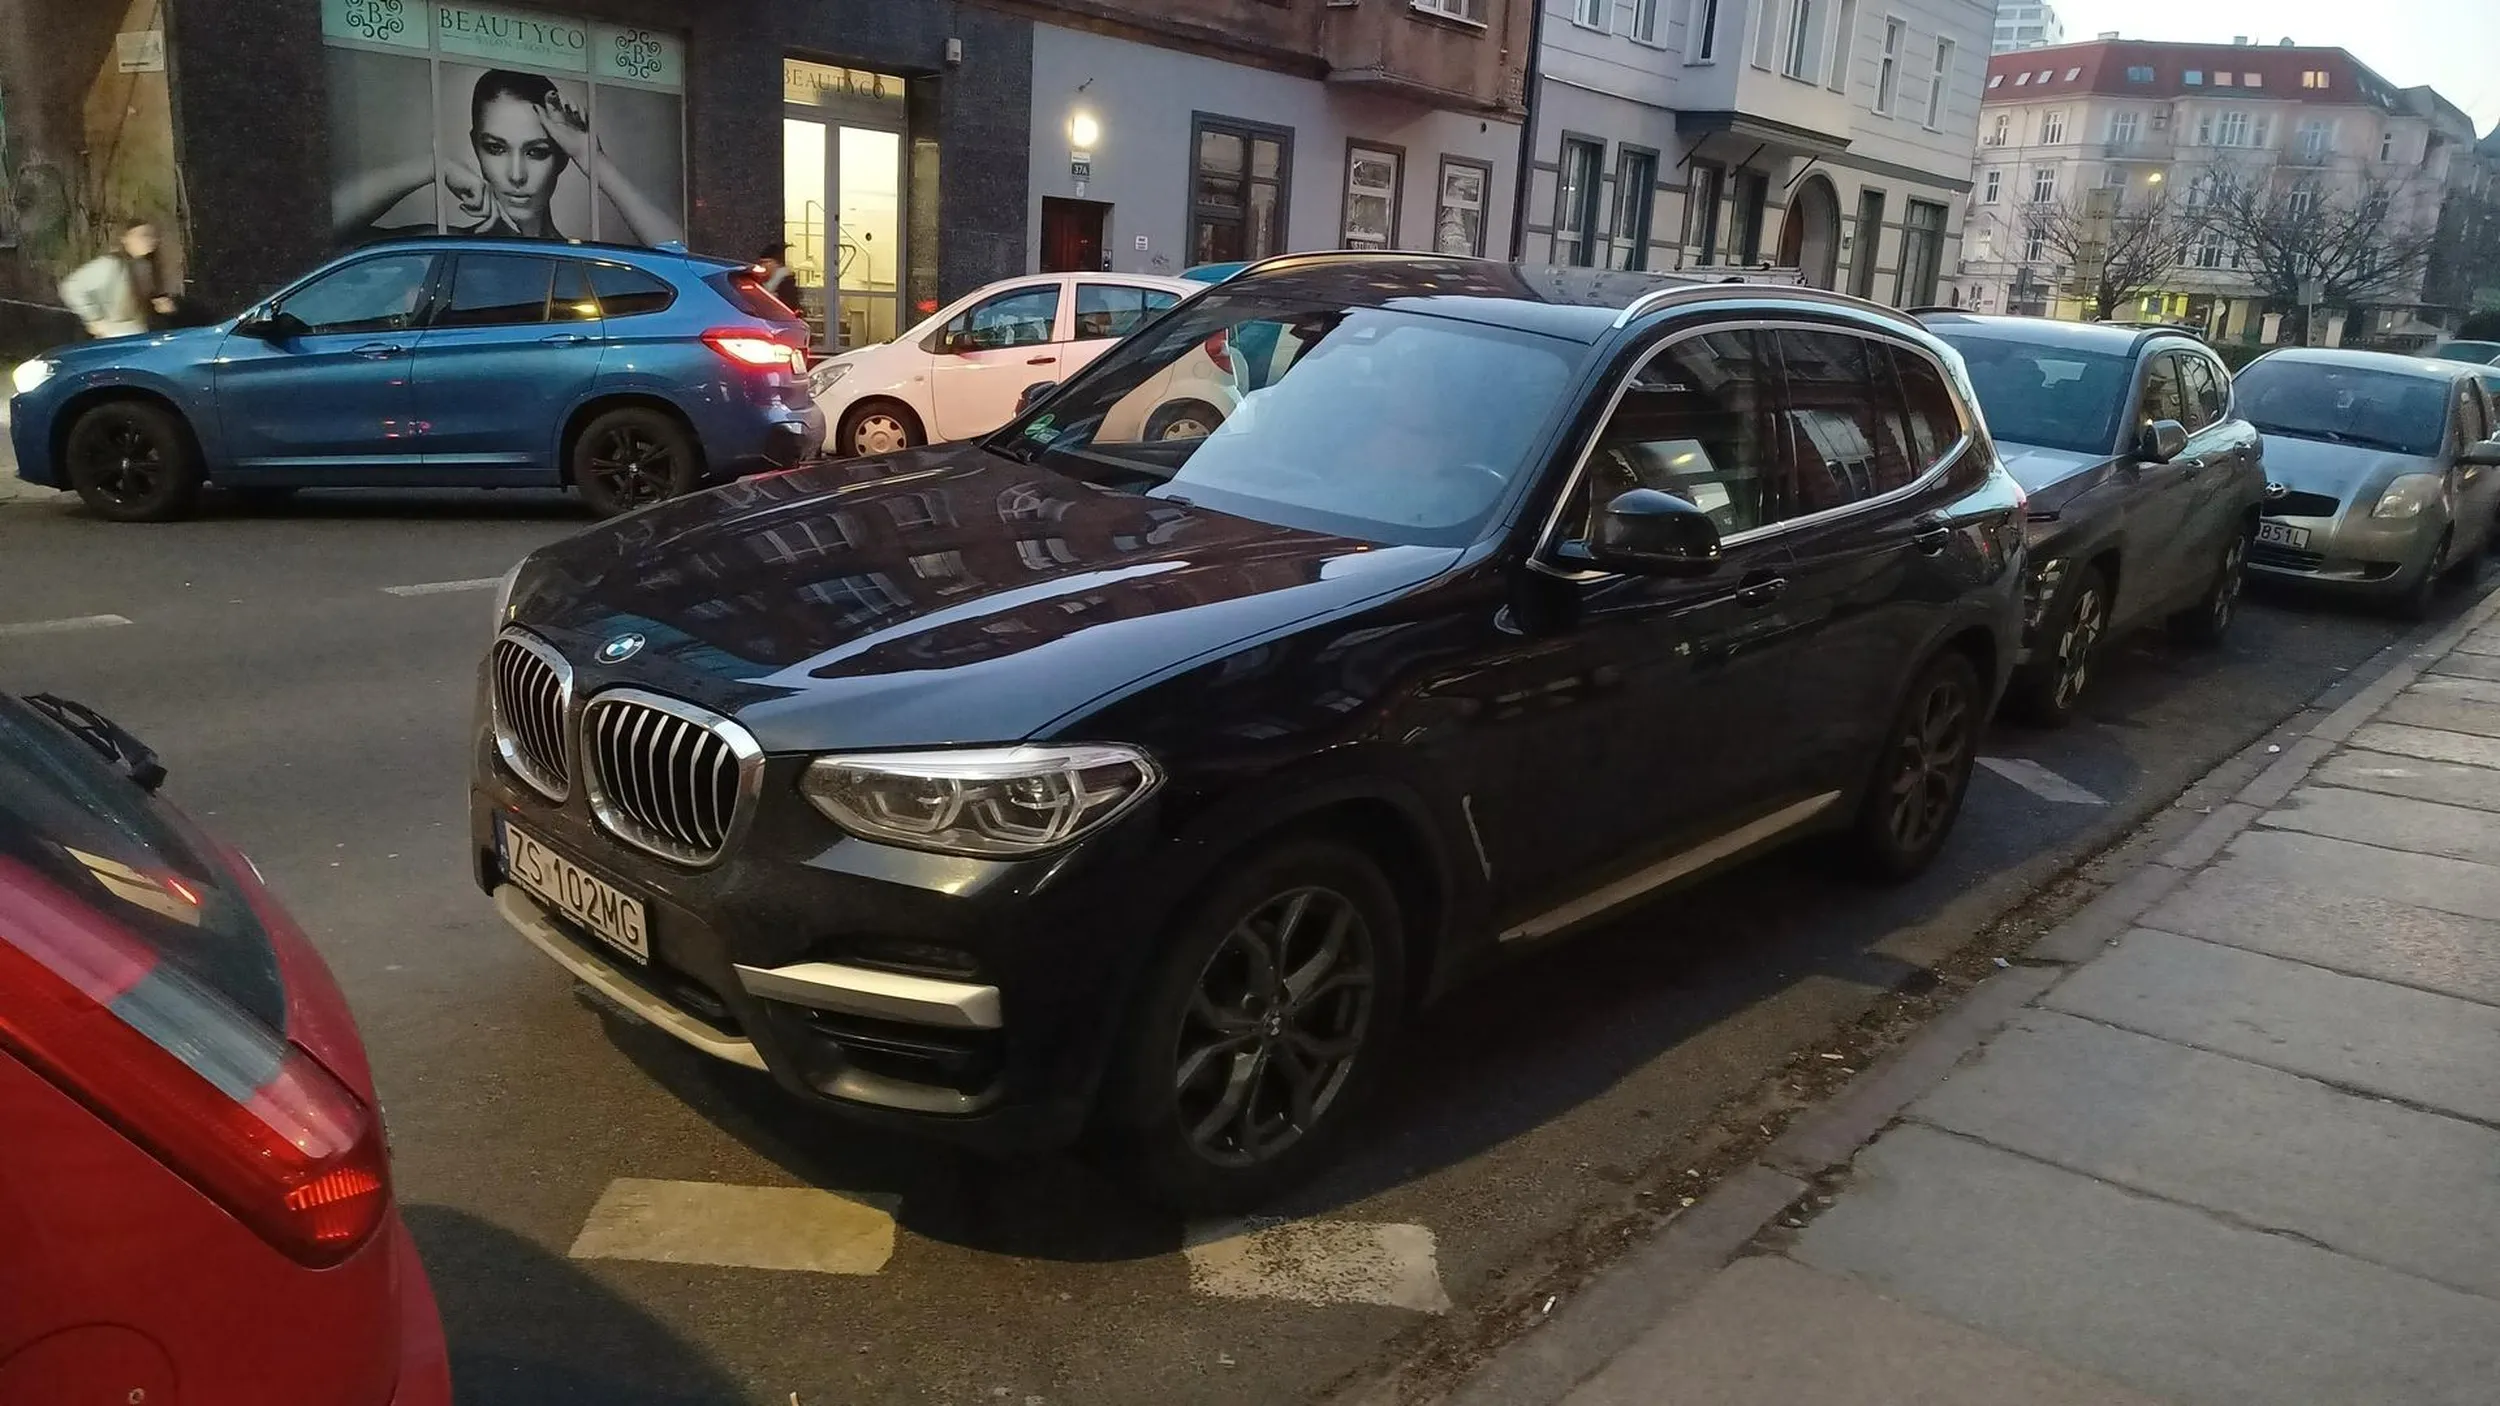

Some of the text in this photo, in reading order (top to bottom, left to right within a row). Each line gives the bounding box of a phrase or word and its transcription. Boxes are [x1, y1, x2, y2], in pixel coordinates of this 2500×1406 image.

[440, 8, 585, 49] BEAUTYCO
[1073, 164, 1088, 175] 37A
[510, 828, 543, 886] ZS
[554, 858, 639, 946] 102MG
